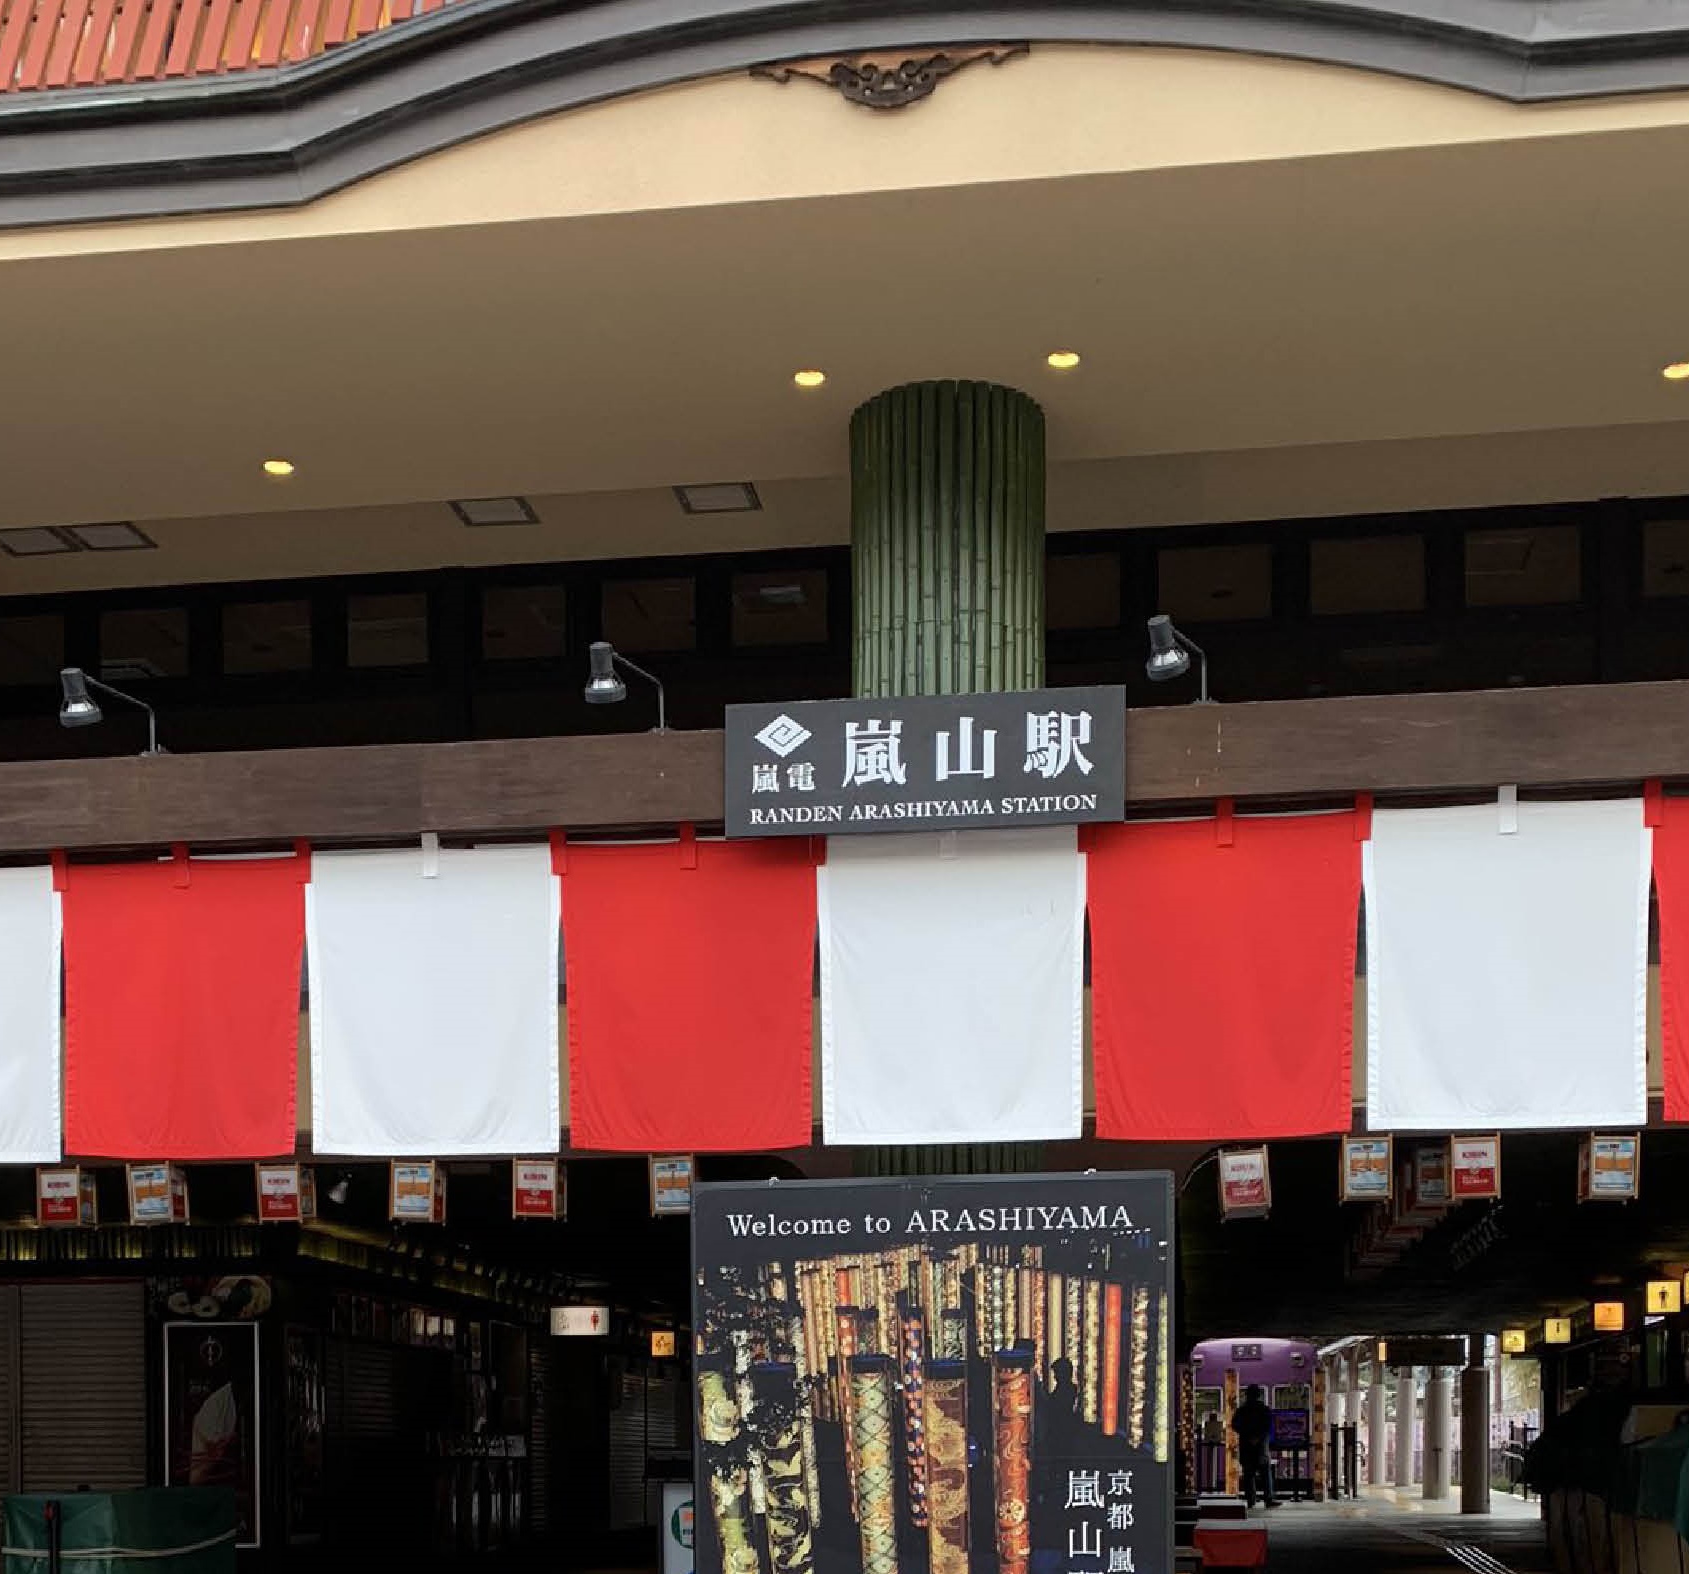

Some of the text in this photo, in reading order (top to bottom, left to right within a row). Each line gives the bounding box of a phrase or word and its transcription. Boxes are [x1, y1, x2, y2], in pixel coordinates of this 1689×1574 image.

[842, 710, 1095, 788] 嵐山駅
[751, 762, 815, 794] 嵐電
[750, 794, 1097, 825] RANDEN ARASHIYAMA STATION
[726, 1205, 1134, 1237] Welcome to ARASHIYAMA
[1107, 1469, 1135, 1531] 京都
